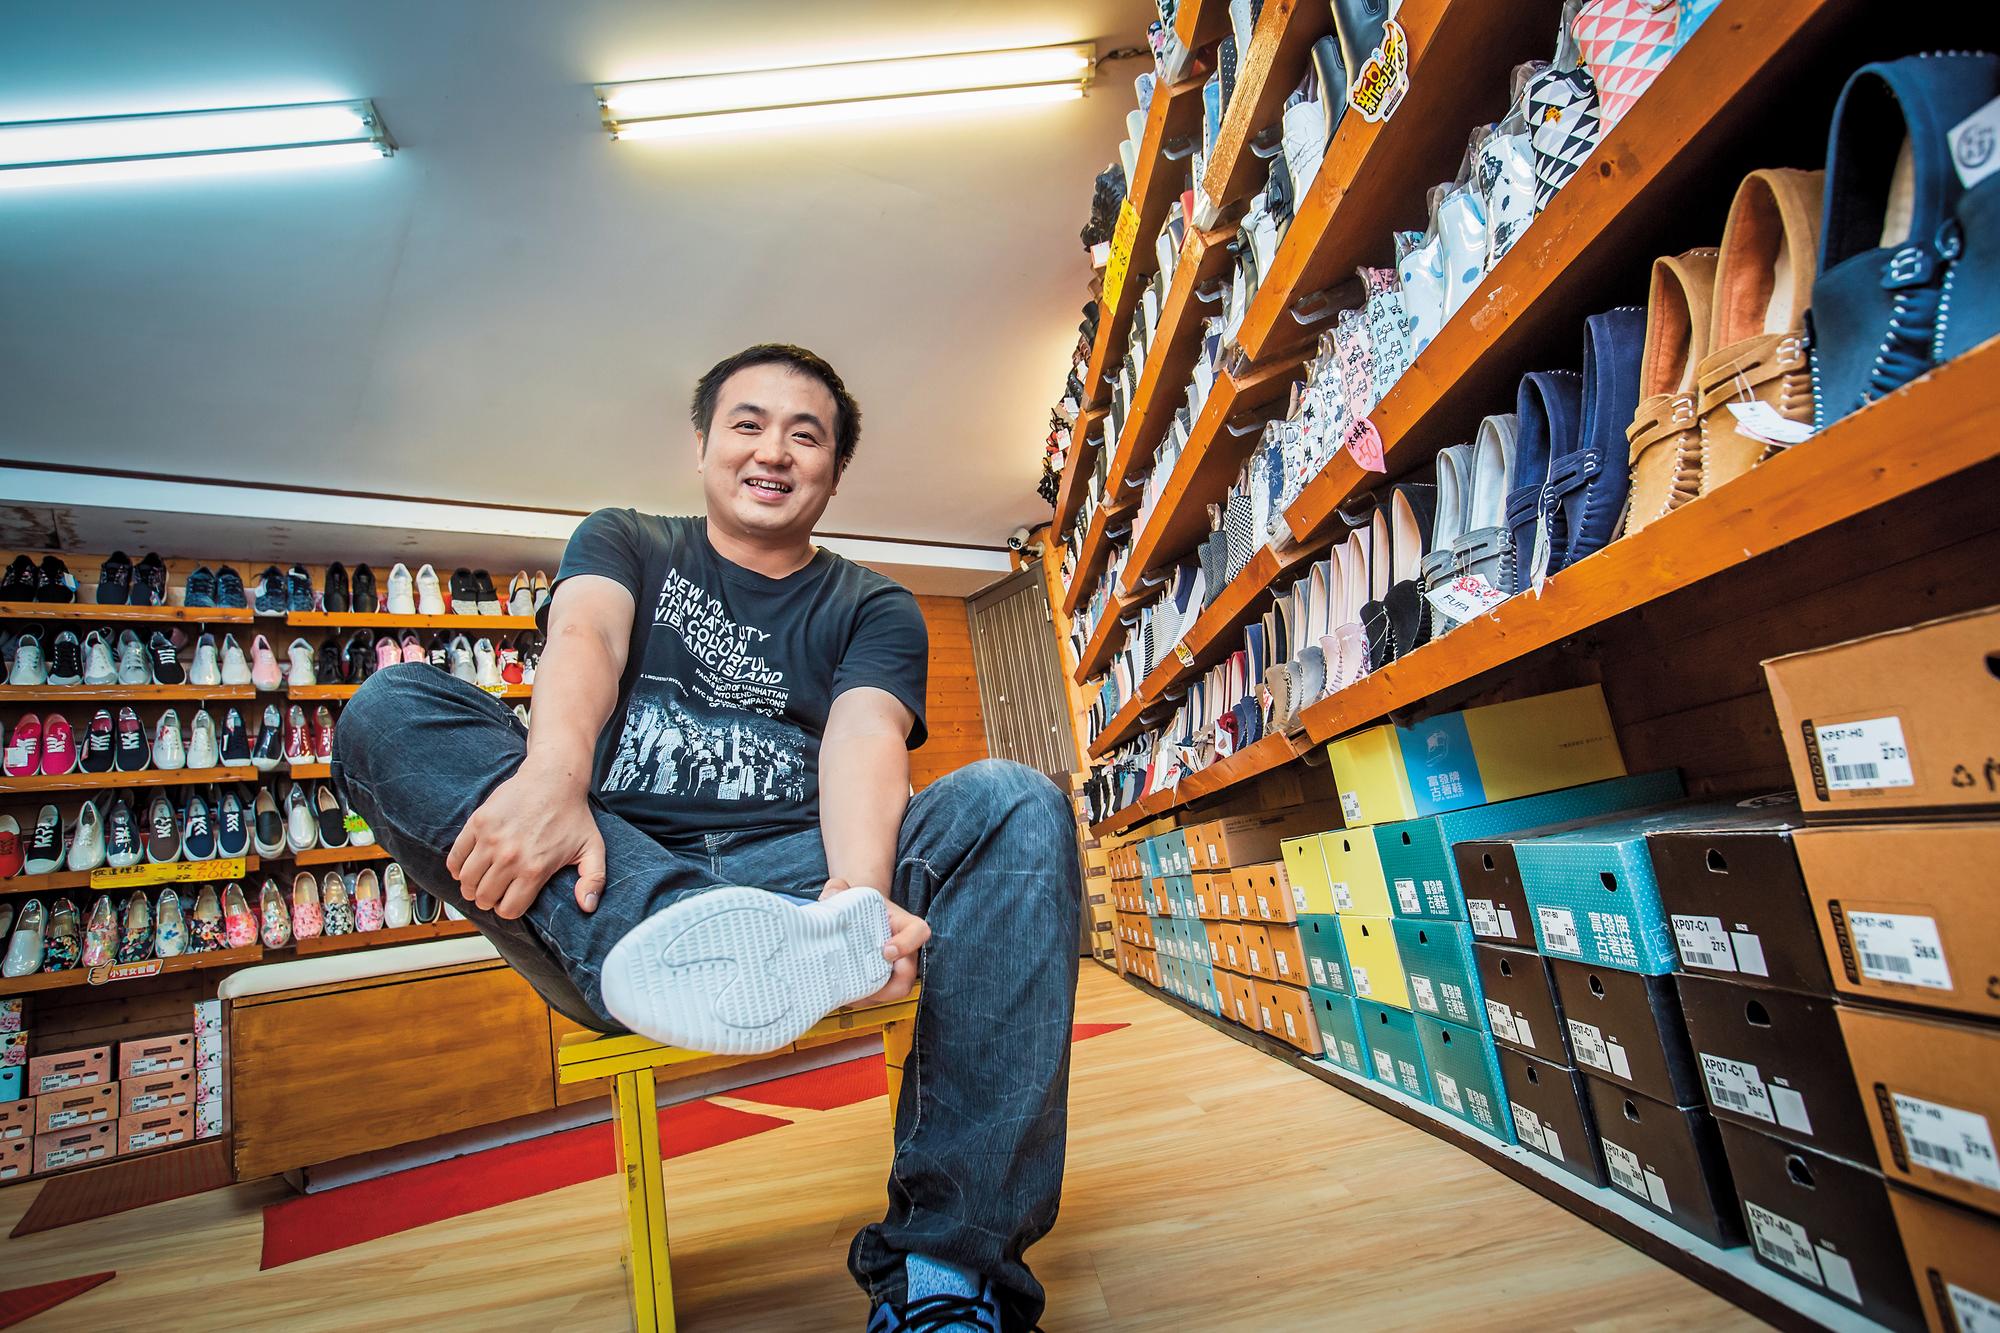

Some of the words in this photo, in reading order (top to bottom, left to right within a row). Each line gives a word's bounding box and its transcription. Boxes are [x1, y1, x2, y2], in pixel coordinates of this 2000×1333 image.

[668, 567, 704, 602] NEW
[1443, 594, 1470, 612] FUFA
[662, 579, 747, 656] MANHATTAN
[695, 668, 716, 688] PACKS
[717, 658, 783, 684] ISLAND
[692, 685, 706, 699] NYC
[742, 684, 789, 701] MANHATTAN
[1803, 725, 1829, 795] BARCODE
[1588, 911, 1630, 938] 富發牌
[1673, 919, 1709, 932] XP07-C1
[1711, 941, 1727, 952] 275
[1570, 1023, 1593, 1037] XP07-C1
[1703, 1058, 1745, 1078] XP07-C1
[1746, 1085, 1765, 1099] 265
[1604, 1141, 1630, 1164] XP07-A0
